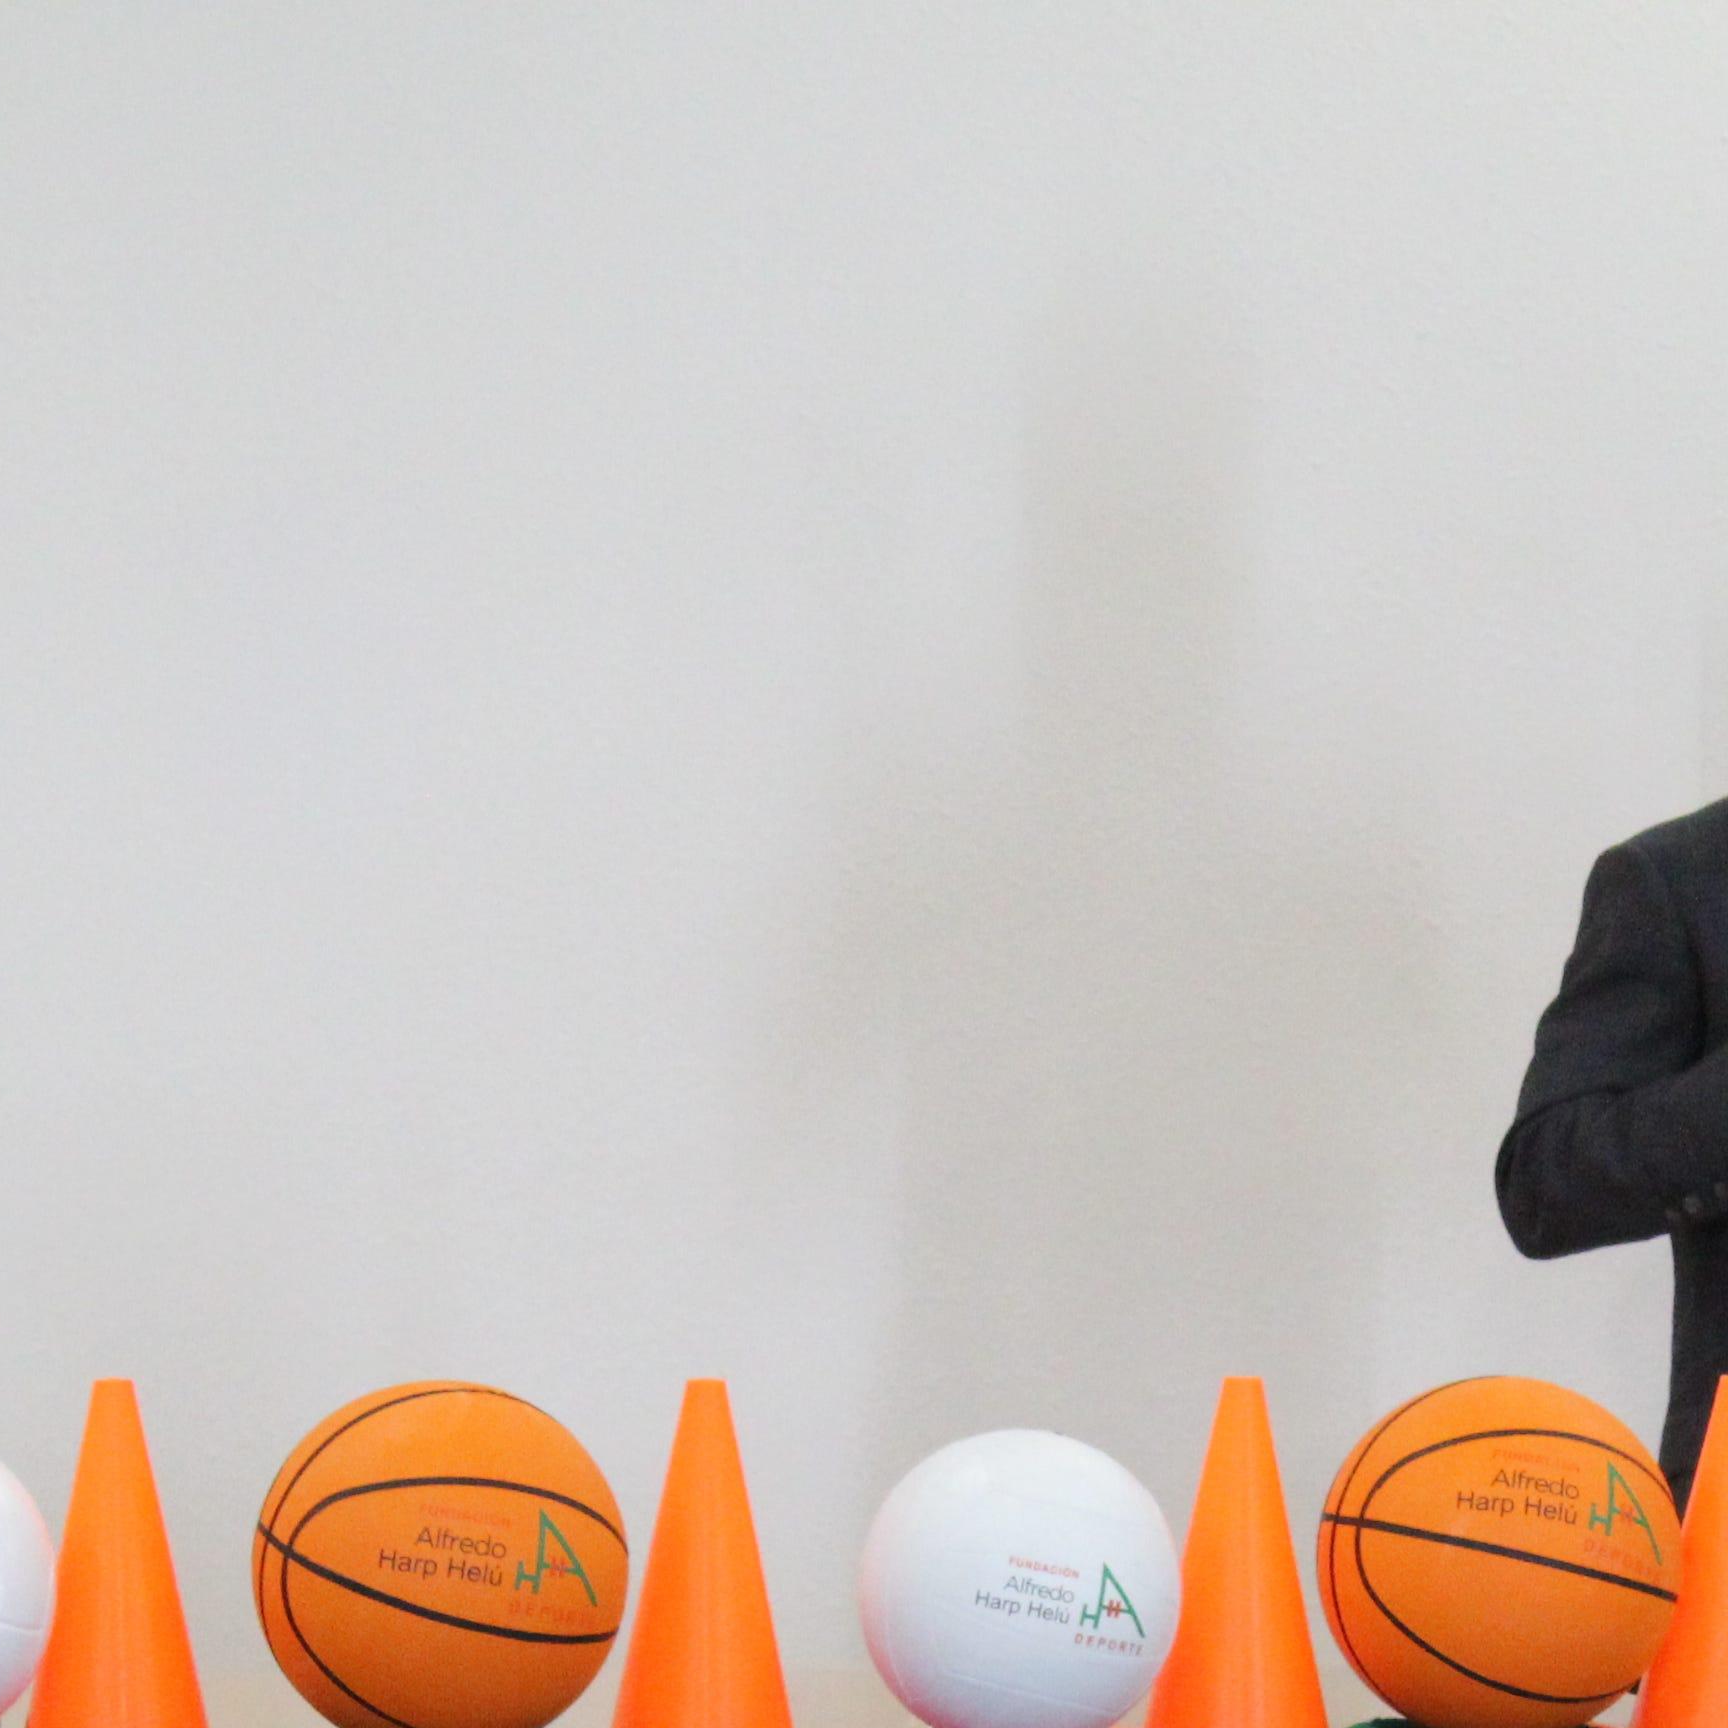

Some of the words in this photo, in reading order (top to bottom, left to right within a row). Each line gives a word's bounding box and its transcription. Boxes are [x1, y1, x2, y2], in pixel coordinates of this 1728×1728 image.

[1491, 1469, 1580, 1498] Alfredo
[1456, 1492, 1514, 1518] Harp
[1525, 1497, 1577, 1525] Helú
[415, 1527, 506, 1559] Alfredo
[378, 1549, 437, 1578] Harp
[447, 1560, 503, 1587] Helú
[1004, 1576, 1074, 1603] Alfredo
[975, 1591, 1020, 1614] Harp
[1028, 1604, 1070, 1624] Helú
[1074, 1633, 1143, 1656] DEPORTE
